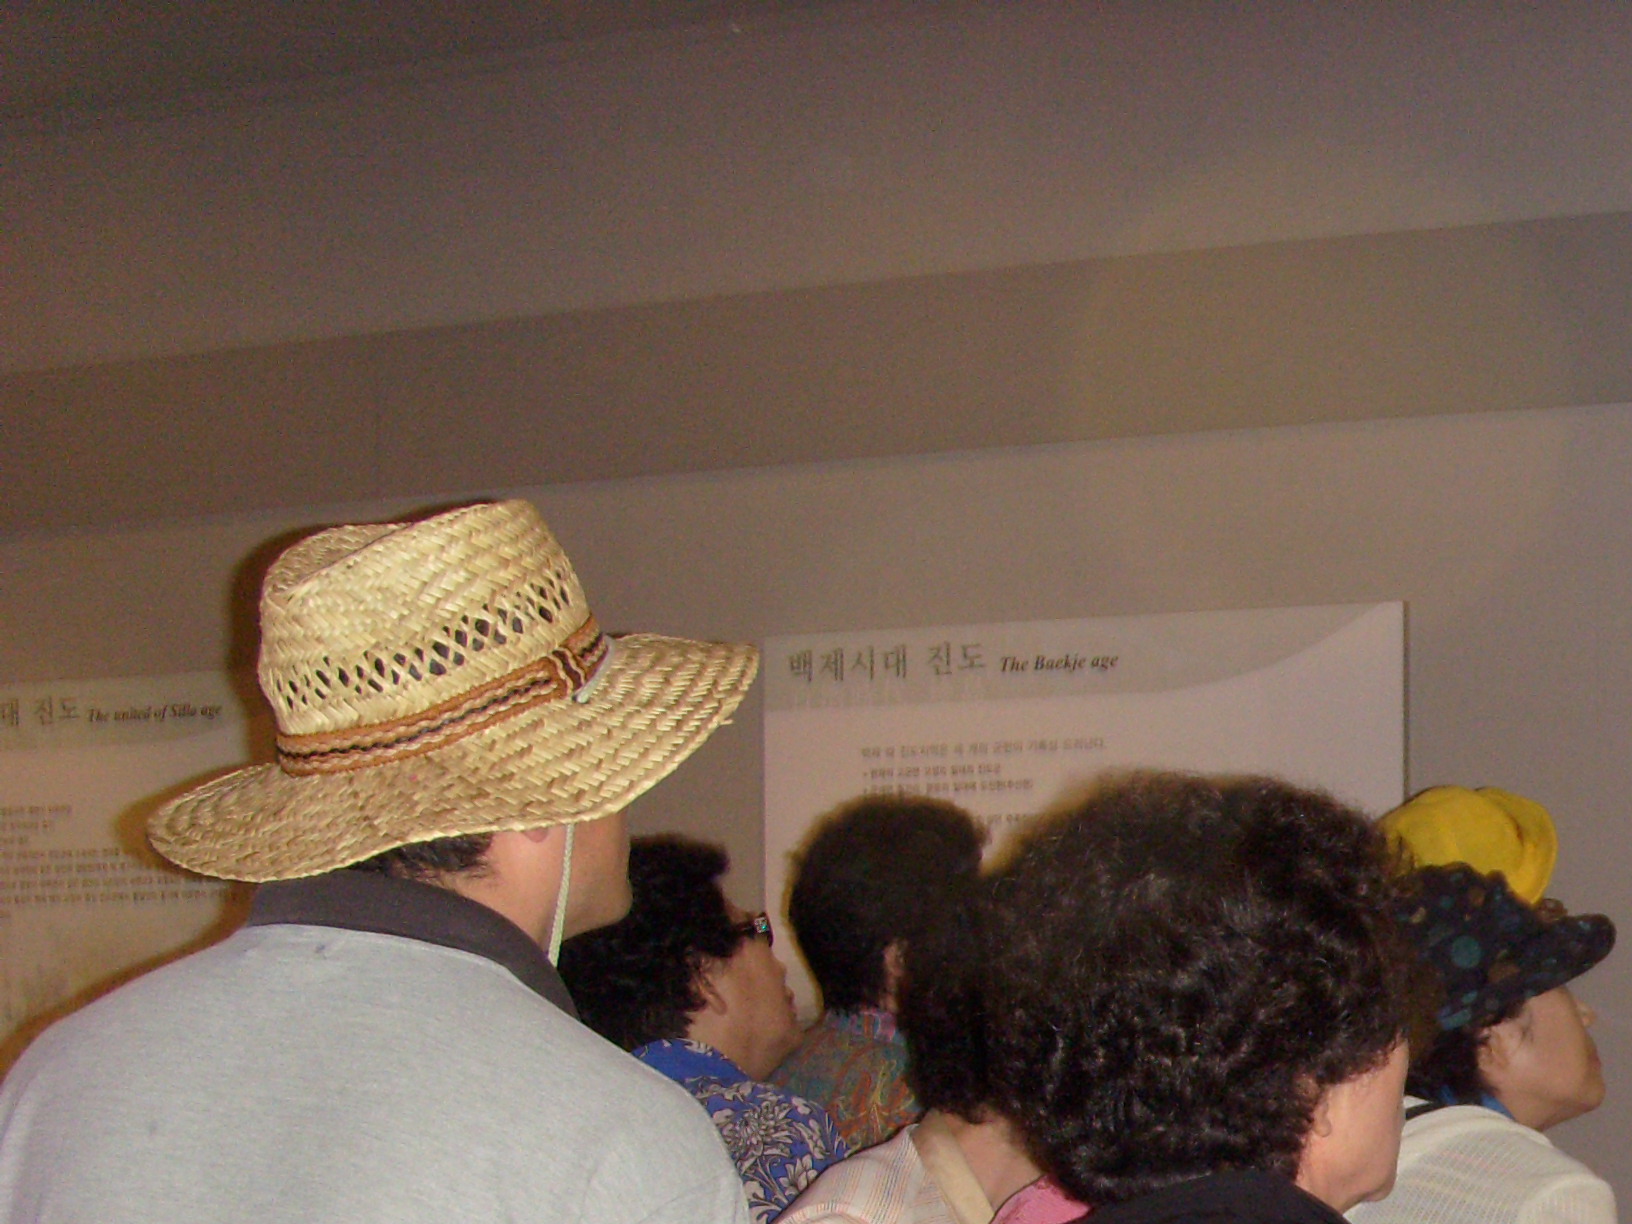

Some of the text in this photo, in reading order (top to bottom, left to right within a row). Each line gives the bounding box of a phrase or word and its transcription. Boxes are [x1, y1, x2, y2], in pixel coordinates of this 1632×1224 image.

[787, 640, 987, 682] 백제시대 진도
[1000, 654, 1119, 673] The Baekje age
[34, 695, 80, 727] 진도
[87, 708, 110, 722] The
[153, 703, 168, 722] of
[200, 704, 223, 720] age
